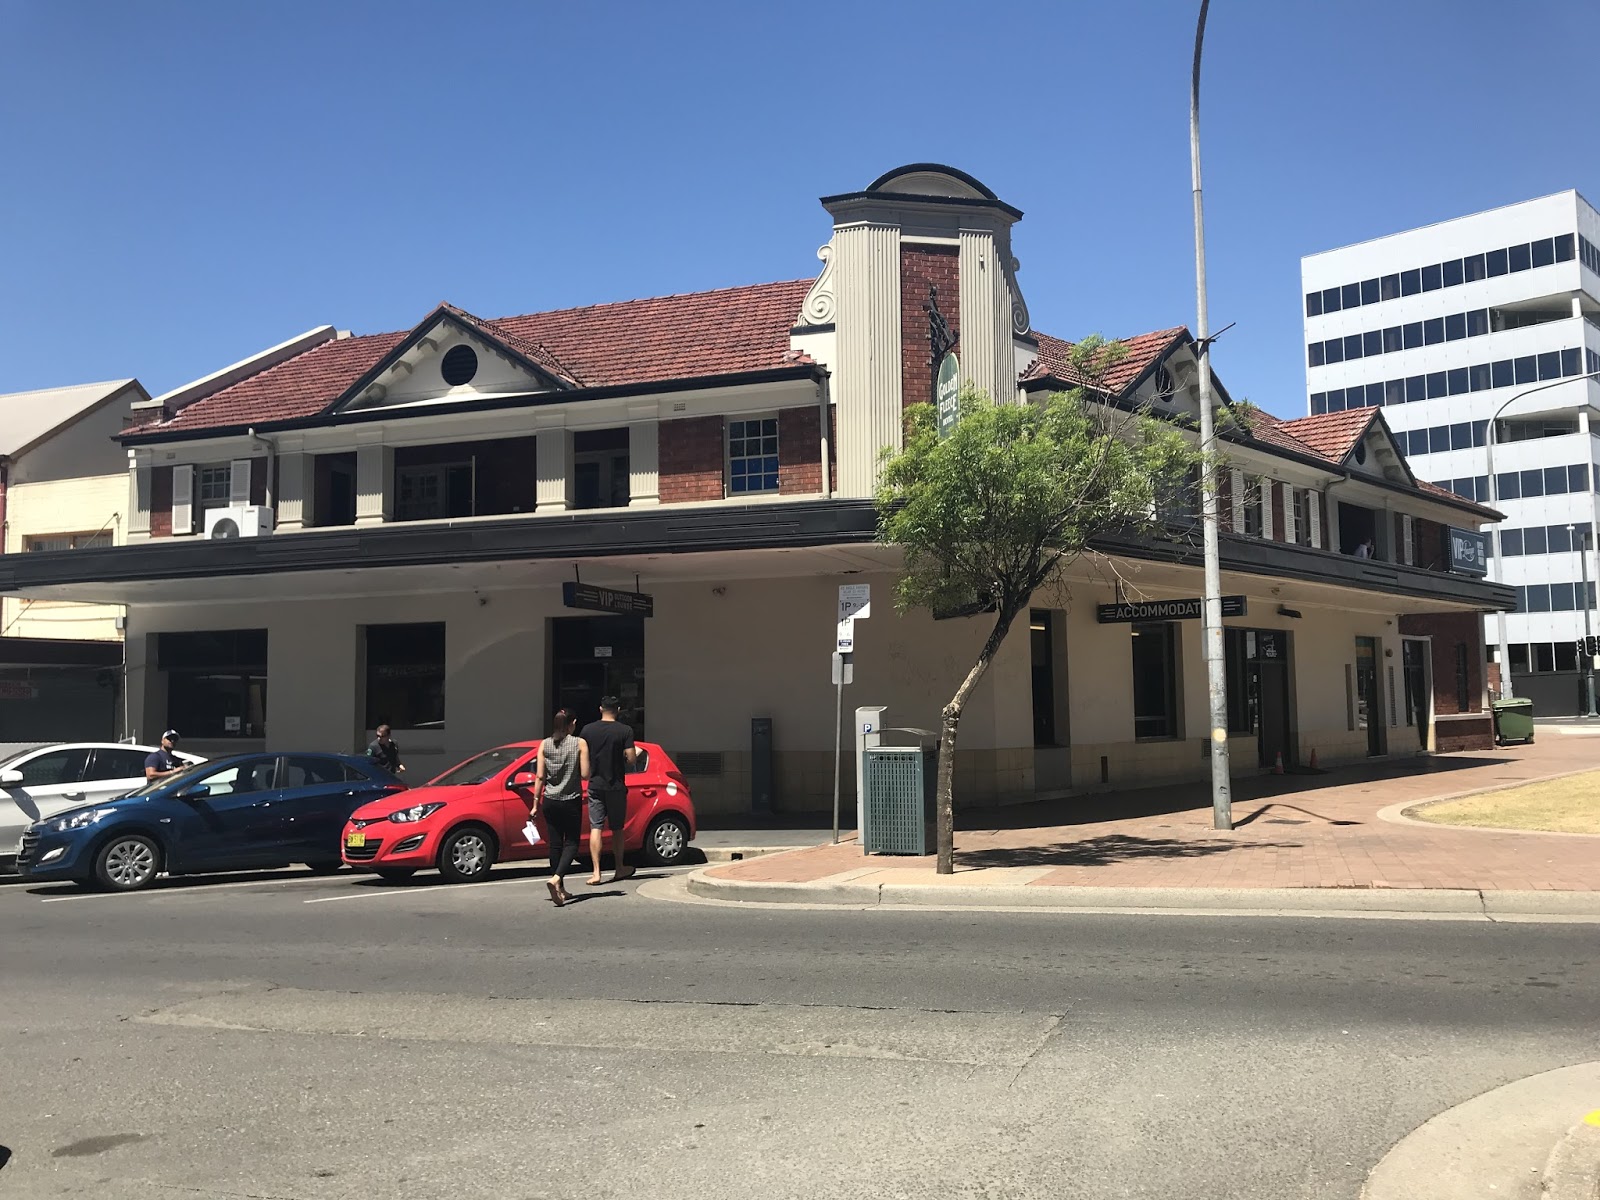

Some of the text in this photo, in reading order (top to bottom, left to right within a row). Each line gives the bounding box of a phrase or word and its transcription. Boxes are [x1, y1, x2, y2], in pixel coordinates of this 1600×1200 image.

[939, 373, 957, 400] GOLDEN
[940, 393, 957, 419] FLEECE
[1453, 537, 1464, 560] VIP
[599, 590, 613, 607] VIP
[841, 602, 852, 611] 1P
[1116, 602, 1201, 619] ACCOMMODAT
